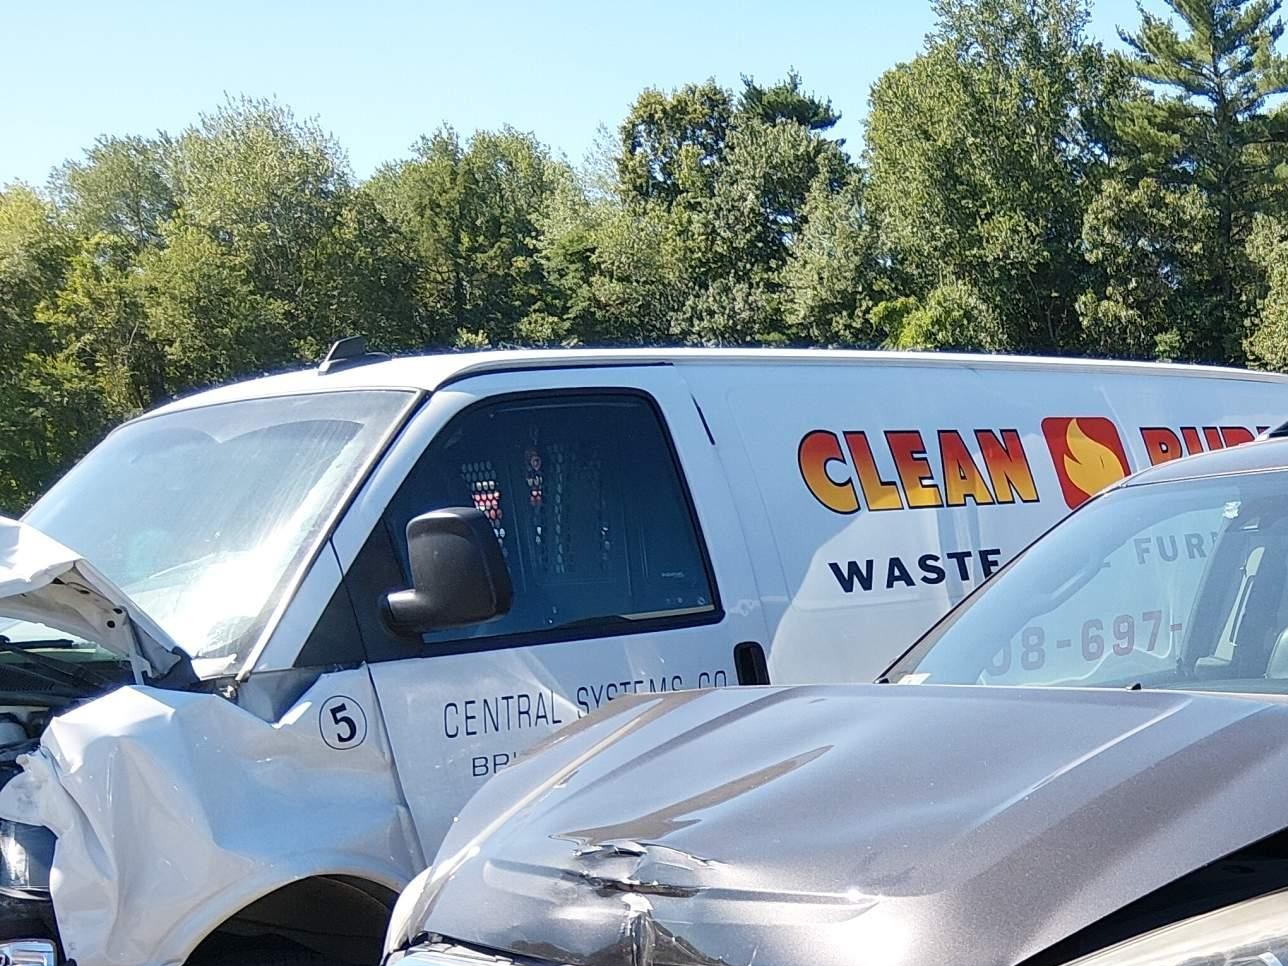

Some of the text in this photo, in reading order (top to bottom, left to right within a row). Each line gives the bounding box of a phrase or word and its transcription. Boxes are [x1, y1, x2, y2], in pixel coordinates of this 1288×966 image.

[798, 429, 1041, 515] CLEAN
[828, 548, 1002, 593] WASTE
[329, 702, 358, 744] 5
[443, 688, 563, 739] CENTRAL
